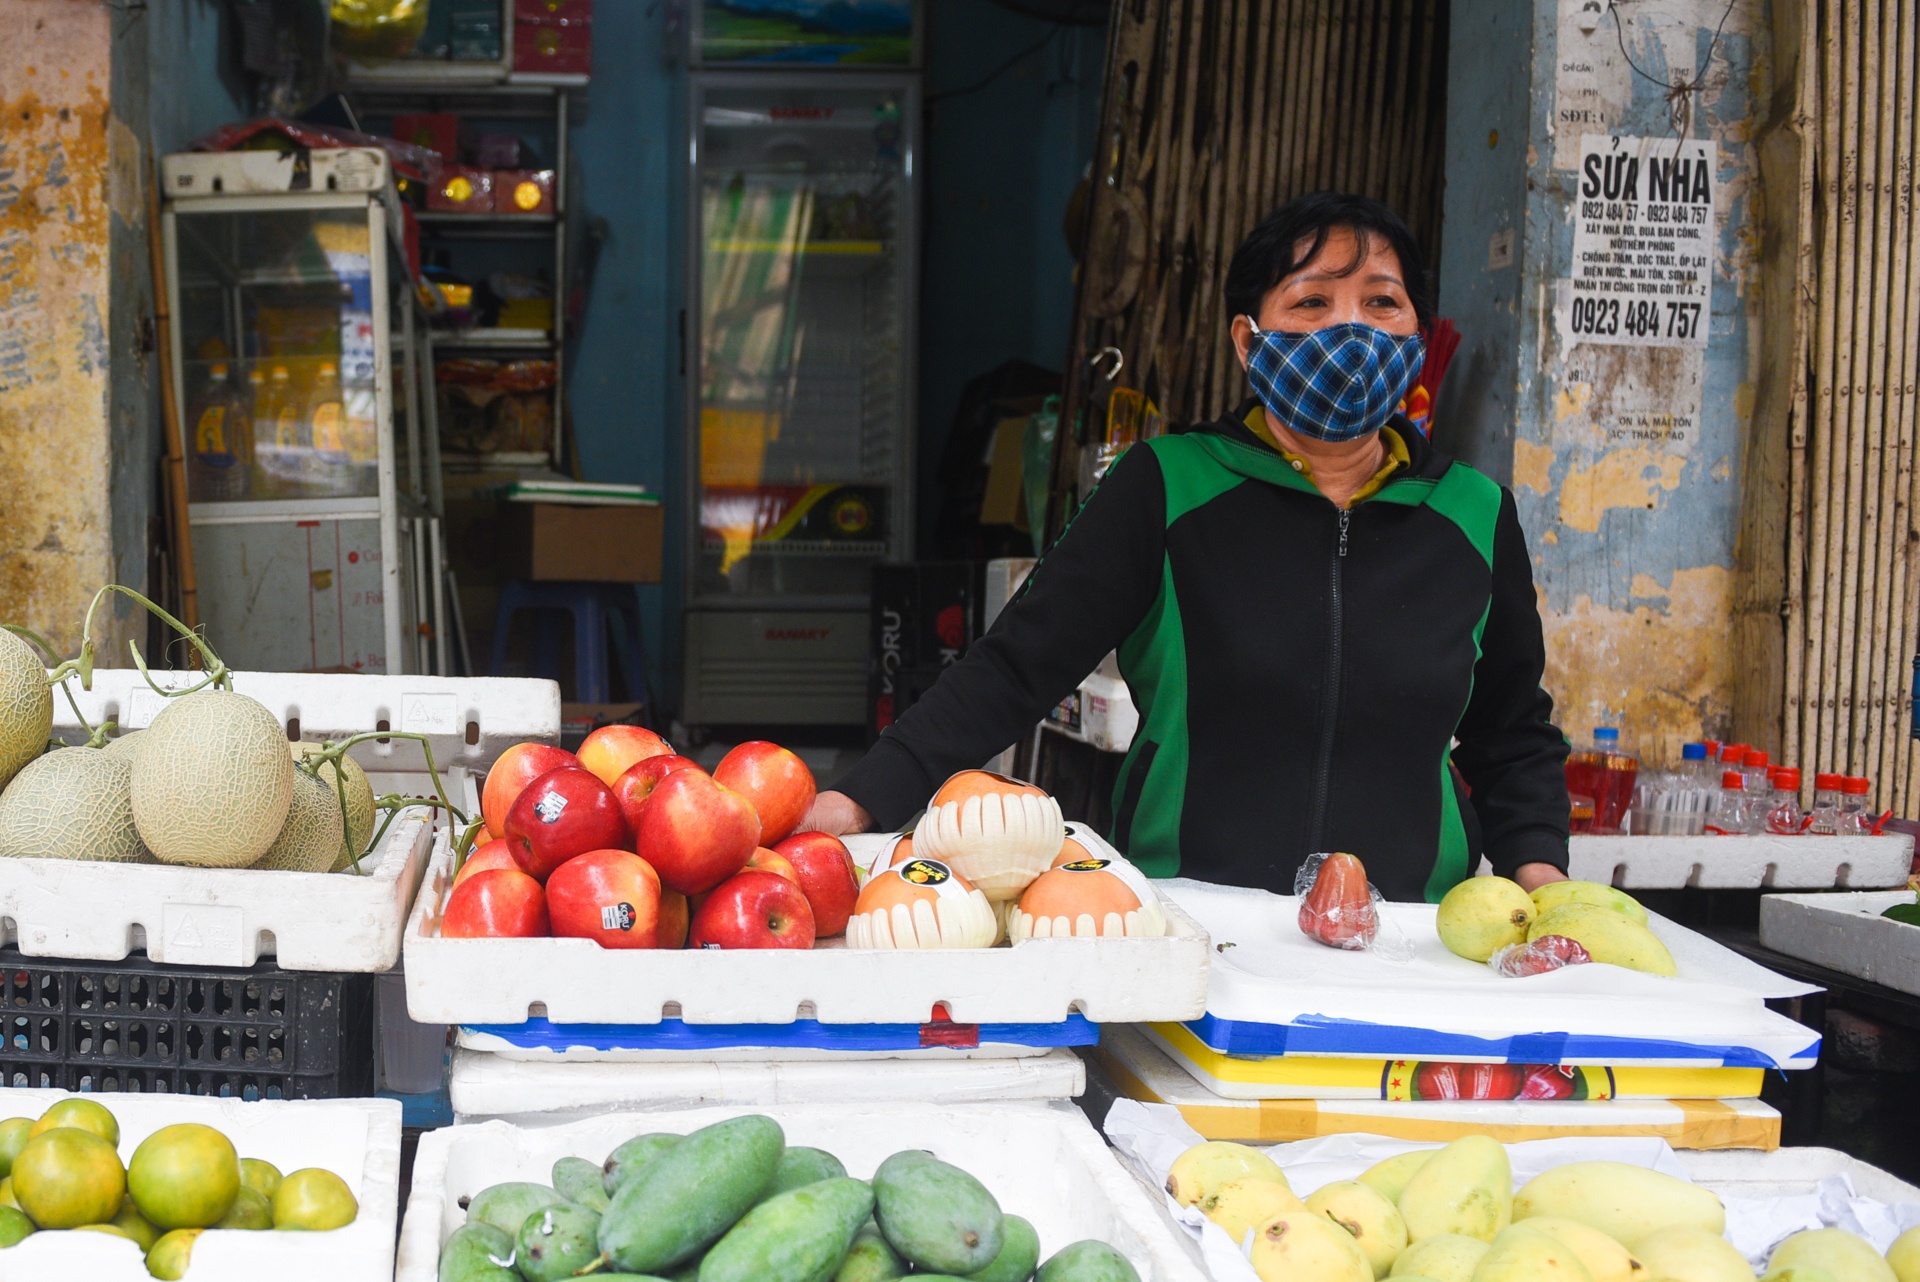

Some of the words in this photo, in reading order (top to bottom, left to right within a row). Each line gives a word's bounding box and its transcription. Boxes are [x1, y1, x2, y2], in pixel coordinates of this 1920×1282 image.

[1581, 136, 1639, 200] SỬA
[1649, 149, 1711, 204] NHÀ
[1582, 201, 1604, 219] 0923
[1606, 202, 1623, 221] 484
[1647, 204, 1669, 222] 0923
[1672, 205, 1688, 223] 484
[1691, 206, 1708, 224] 757
[1700, 284, 1707, 296] Z
[1571, 297, 1620, 335] 0923
[1625, 300, 1660, 338] 484
[1666, 301, 1701, 339] 757
[619, 903, 631, 928] KORU
